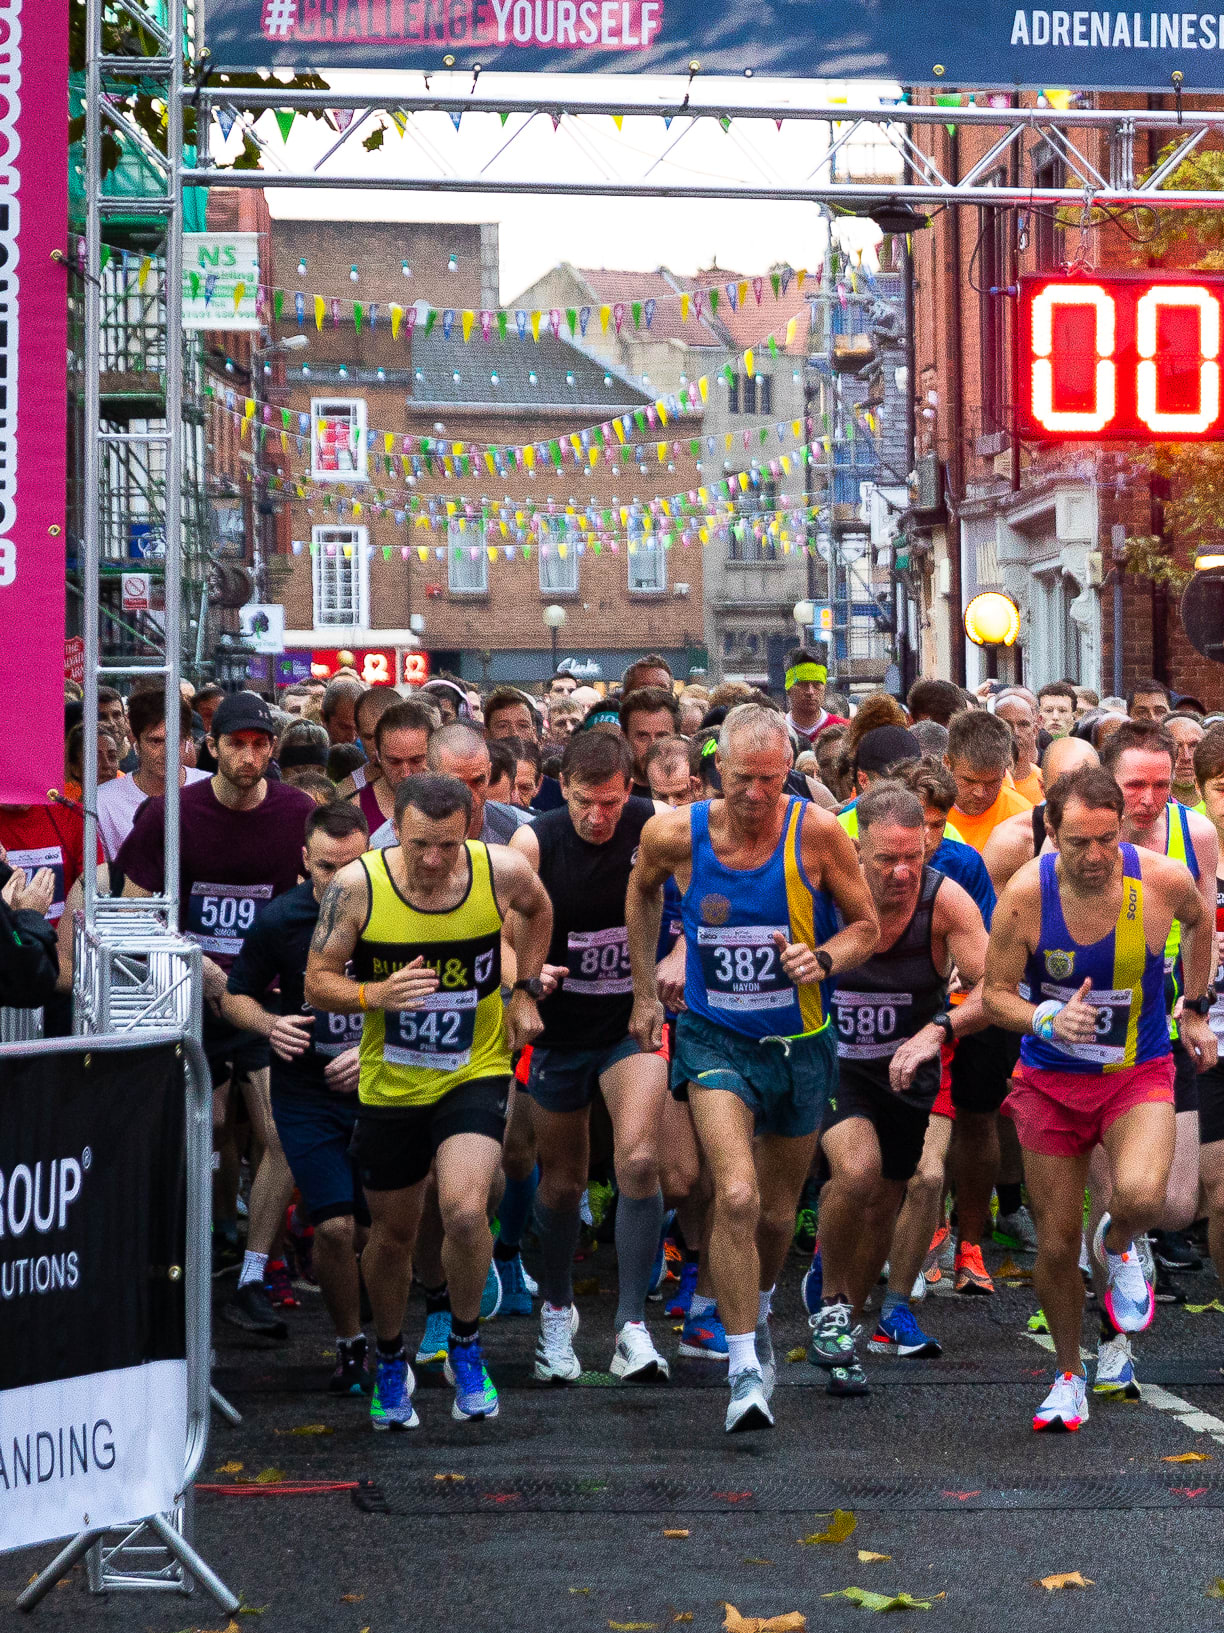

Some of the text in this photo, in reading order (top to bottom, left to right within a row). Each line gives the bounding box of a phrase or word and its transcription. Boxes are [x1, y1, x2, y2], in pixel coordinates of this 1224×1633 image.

[264, 0, 660, 45] #CHALLENGEYOURSELF
[198, 245, 236, 266] NS
[201, 896, 255, 929] 509
[1127, 885, 1138, 921] soar
[213, 927, 237, 937] SIMON
[442, 958, 468, 988] &
[581, 944, 631, 974] 805
[714, 947, 776, 982] 382
[400, 1011, 461, 1044] 542
[837, 1006, 896, 1036] 580
[0, 1157, 81, 1235] OUP
